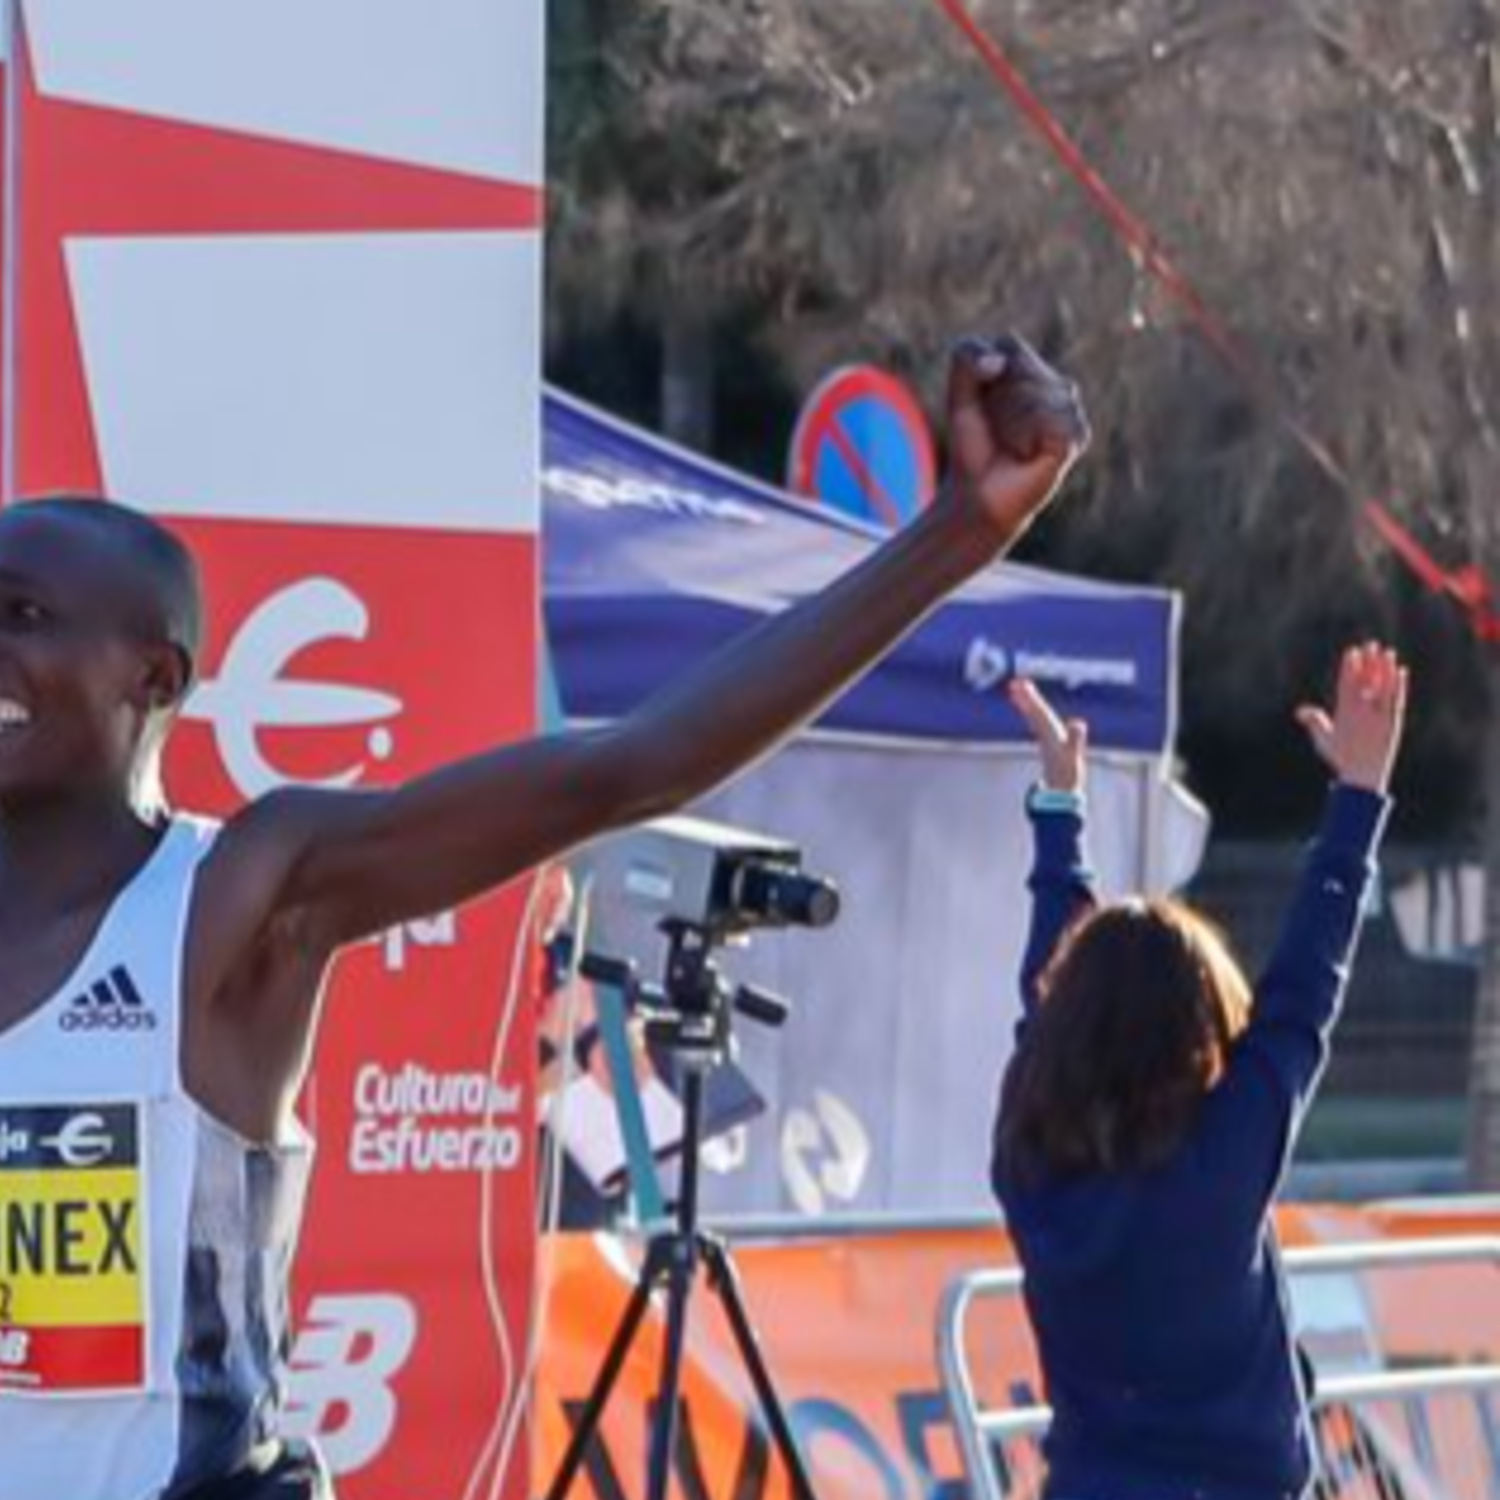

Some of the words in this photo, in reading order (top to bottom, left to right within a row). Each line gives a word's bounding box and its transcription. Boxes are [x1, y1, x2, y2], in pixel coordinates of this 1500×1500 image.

[58, 1006, 156, 1032] adidas
[354, 1059, 486, 1114] Cultura
[349, 1117, 522, 1175] Esfuerzo
